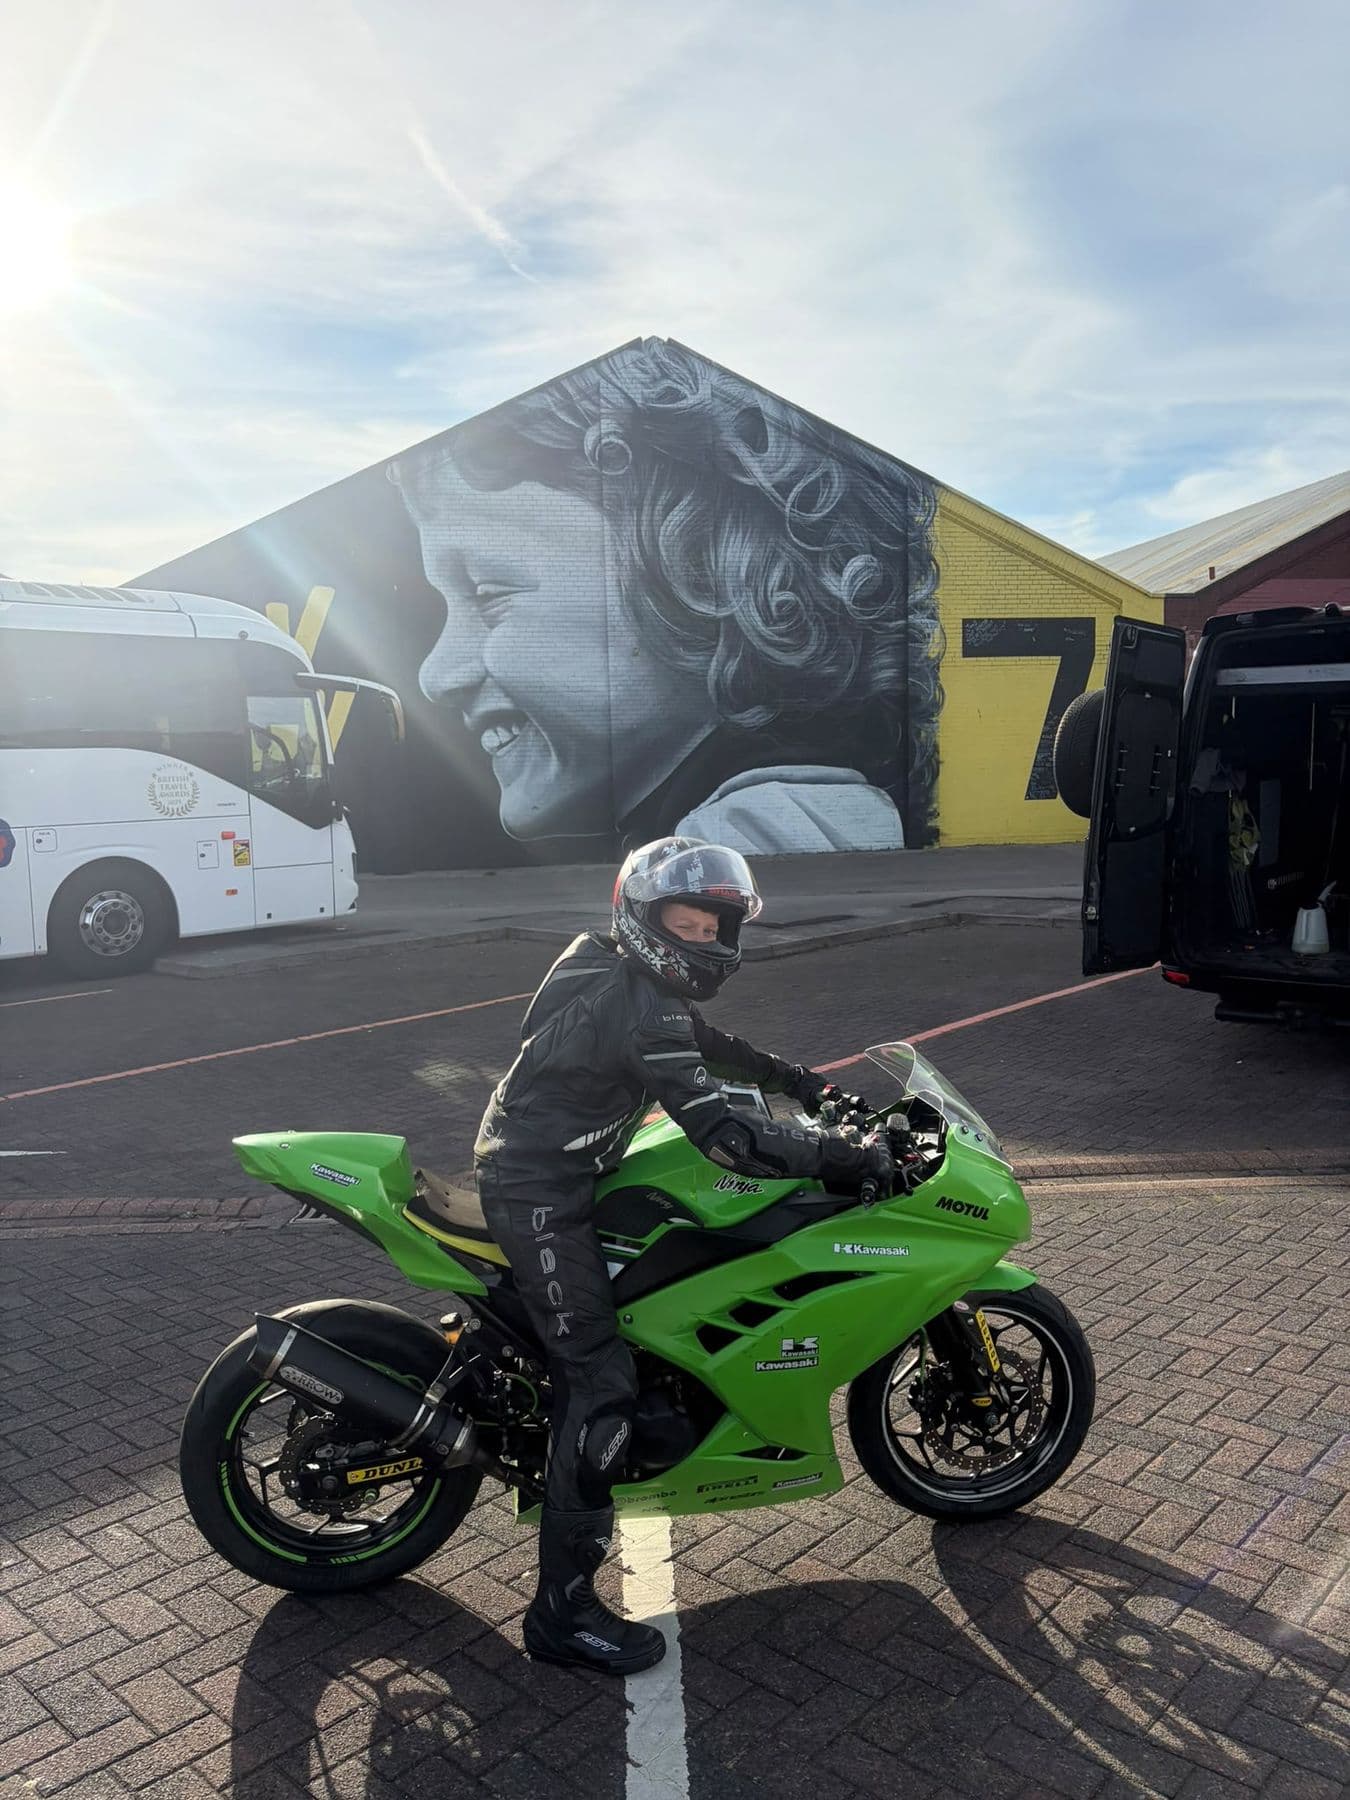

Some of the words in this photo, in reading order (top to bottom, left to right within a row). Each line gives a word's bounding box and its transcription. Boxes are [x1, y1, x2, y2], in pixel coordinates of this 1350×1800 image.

[618, 917, 668, 974] SHARK
[310, 1162, 361, 1185] Kawasaki
[713, 1173, 766, 1196] Ninja
[935, 1195, 990, 1221] MOTUL
[853, 1244, 910, 1257] Kawasaki
[531, 1206, 574, 1337] black
[756, 1357, 819, 1371] Kawasaki
[781, 1348, 819, 1358] Kawasaki
[600, 1421, 628, 1471] RST
[573, 1631, 621, 1652] RST
